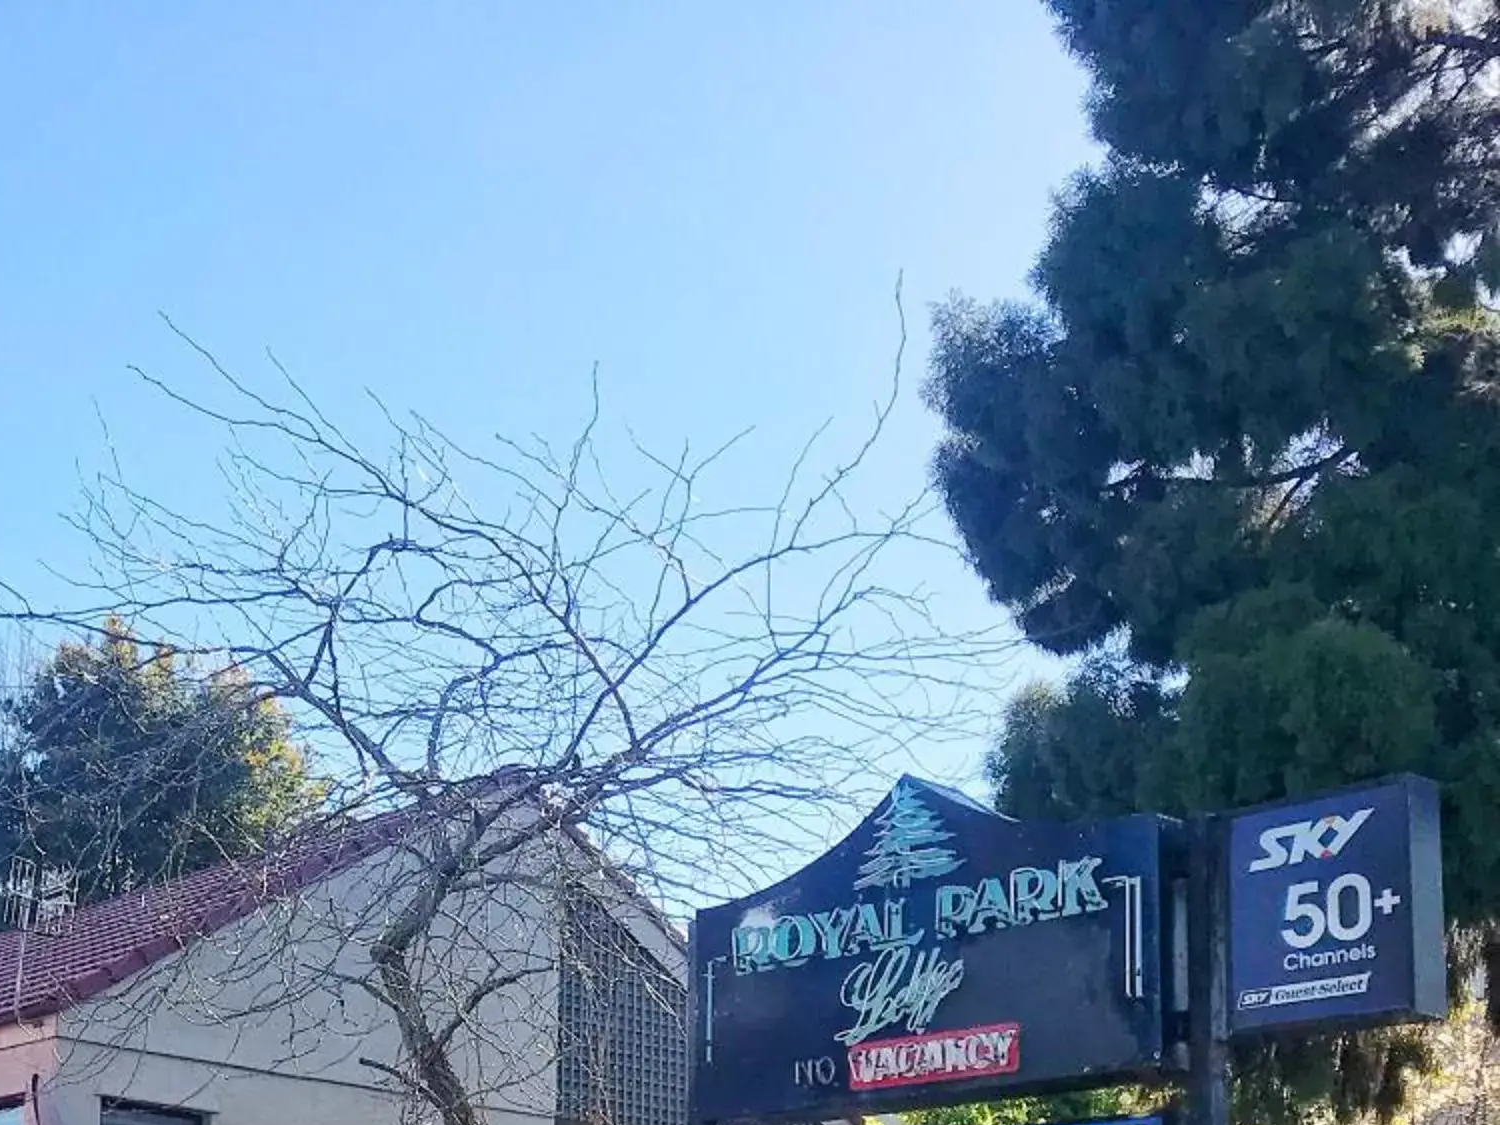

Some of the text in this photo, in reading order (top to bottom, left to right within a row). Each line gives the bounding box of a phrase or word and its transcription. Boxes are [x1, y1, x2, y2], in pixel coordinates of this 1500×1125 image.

[1249, 807, 1375, 872] SKY
[732, 855, 1109, 975] ROYAL PARK
[1281, 873, 1401, 949] 50+
[1283, 944, 1376, 970] Channels
[847, 1029, 1017, 1084] VACANCY
